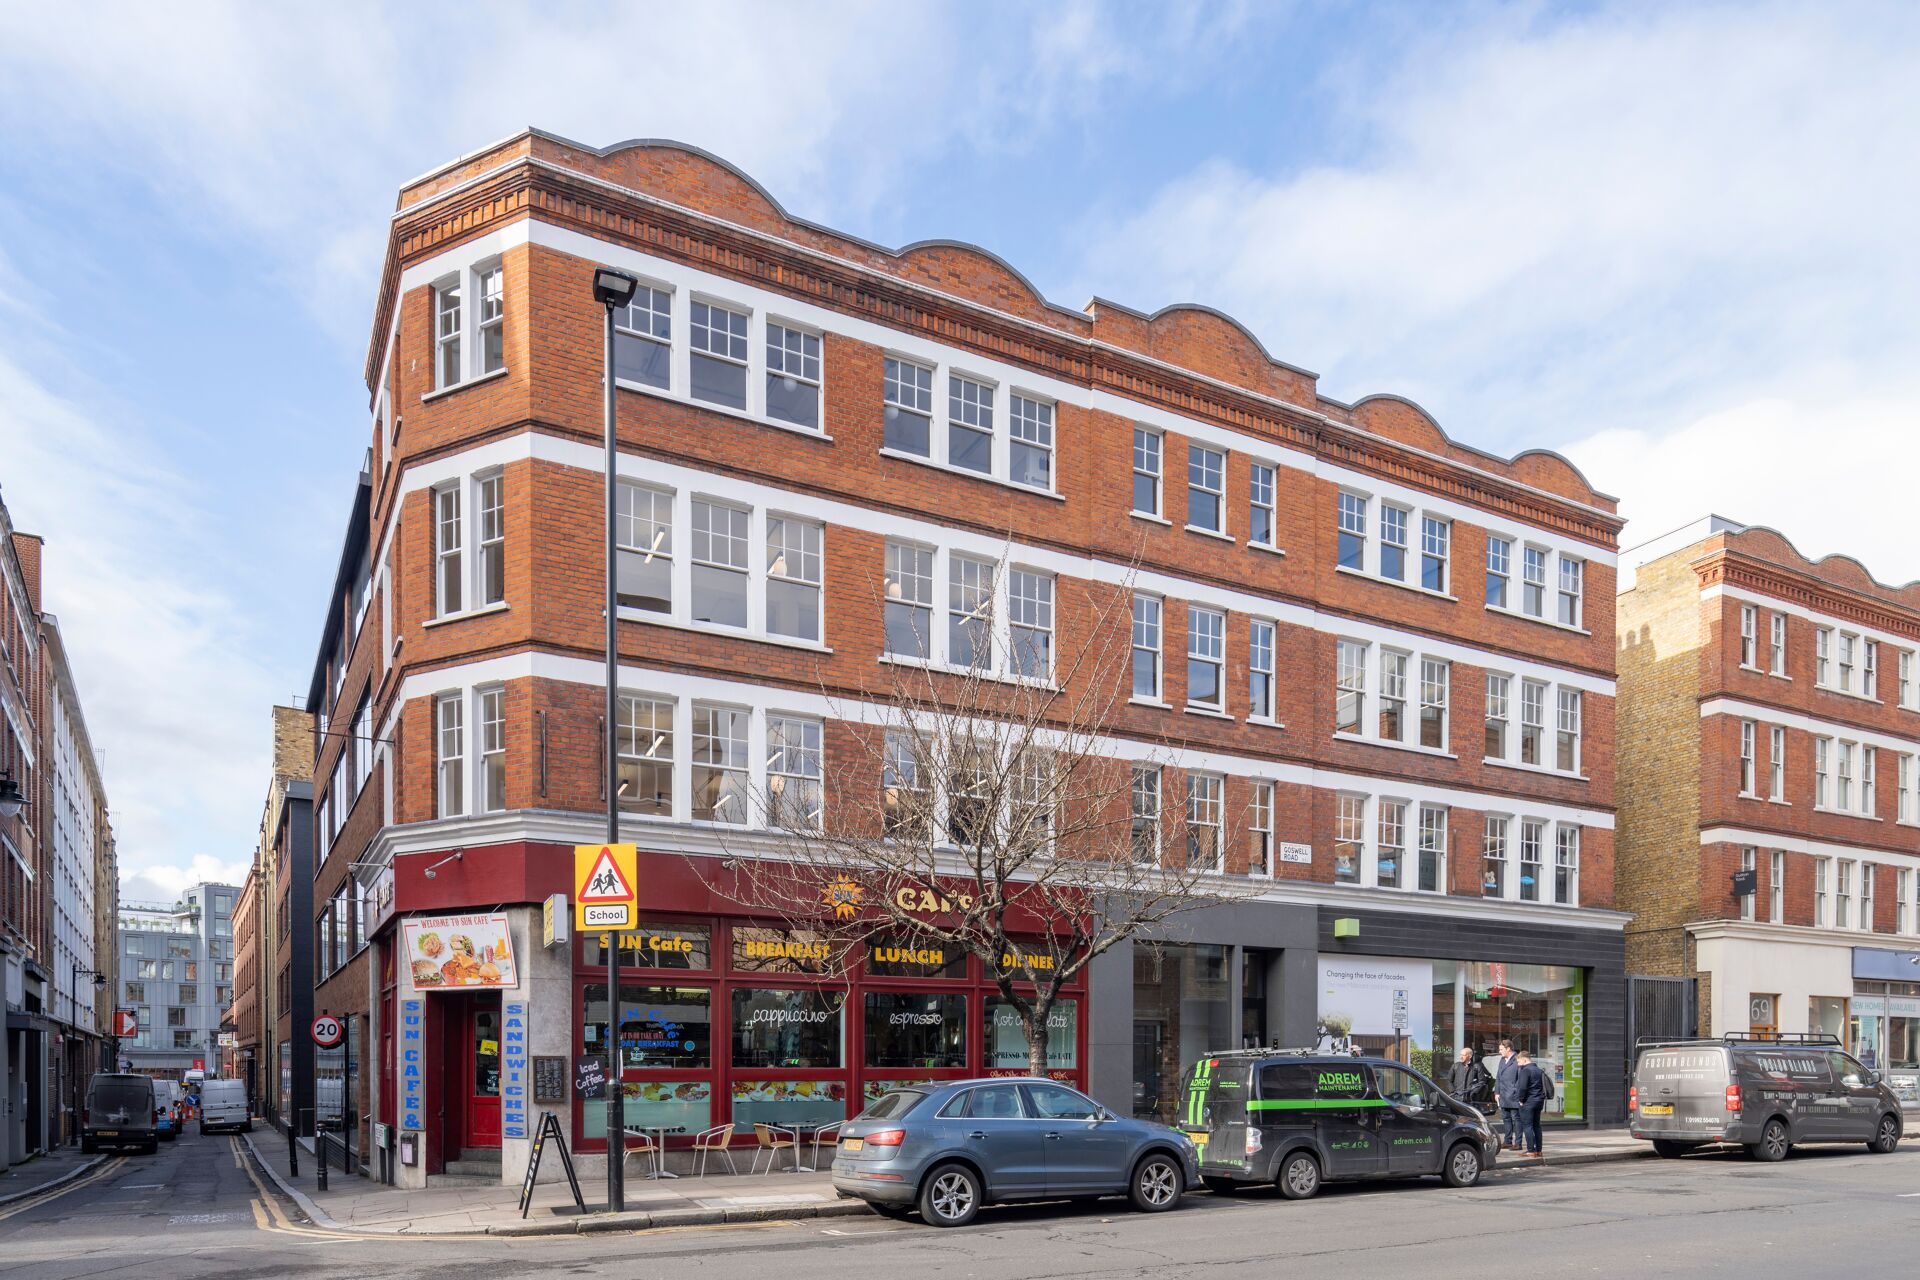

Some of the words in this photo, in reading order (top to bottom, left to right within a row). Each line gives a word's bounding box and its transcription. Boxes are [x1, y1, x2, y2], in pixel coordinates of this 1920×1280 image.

[1283, 846, 1309, 856] GOSWELL
[1283, 853, 1299, 861] ROAD
[421, 917, 449, 929] WELCOME
[452, 918, 460, 927] TO
[461, 917, 473, 926] SUN
[474, 915, 489, 925] CAFE
[589, 910, 624, 920] School
[649, 935, 693, 952] Cafe
[746, 941, 831, 958] BREAKFAST
[875, 947, 944, 964] LUNCH
[1326, 970, 1354, 980] Changing
[1354, 971, 1364, 979] the
[1365, 972, 1377, 980] face
[1378, 972, 1384, 980] of
[1751, 999, 1769, 1021] 69
[1852, 1001, 1864, 1009] NEW
[404, 1001, 421, 1040] SUN
[752, 1008, 828, 1028] cappuccino
[889, 1012, 944, 1030] espresso
[993, 1008, 1014, 1027] hot
[316, 1023, 338, 1036] 20
[1567, 994, 1583, 1079] millboard
[637, 1040, 680, 1048] BREAKFAST
[579, 1060, 600, 1074] Iced
[1645, 1057, 1677, 1069] FUSION
[1680, 1055, 1718, 1067] BLINDS
[1757, 1058, 1788, 1072] FUSION
[504, 1004, 527, 1137] SANDWICHES
[575, 1073, 606, 1090] Coffee
[1190, 1078, 1211, 1087] ADREM
[1318, 1072, 1362, 1085] ADREM
[1393, 1136, 1433, 1146] adrem.co.uk
